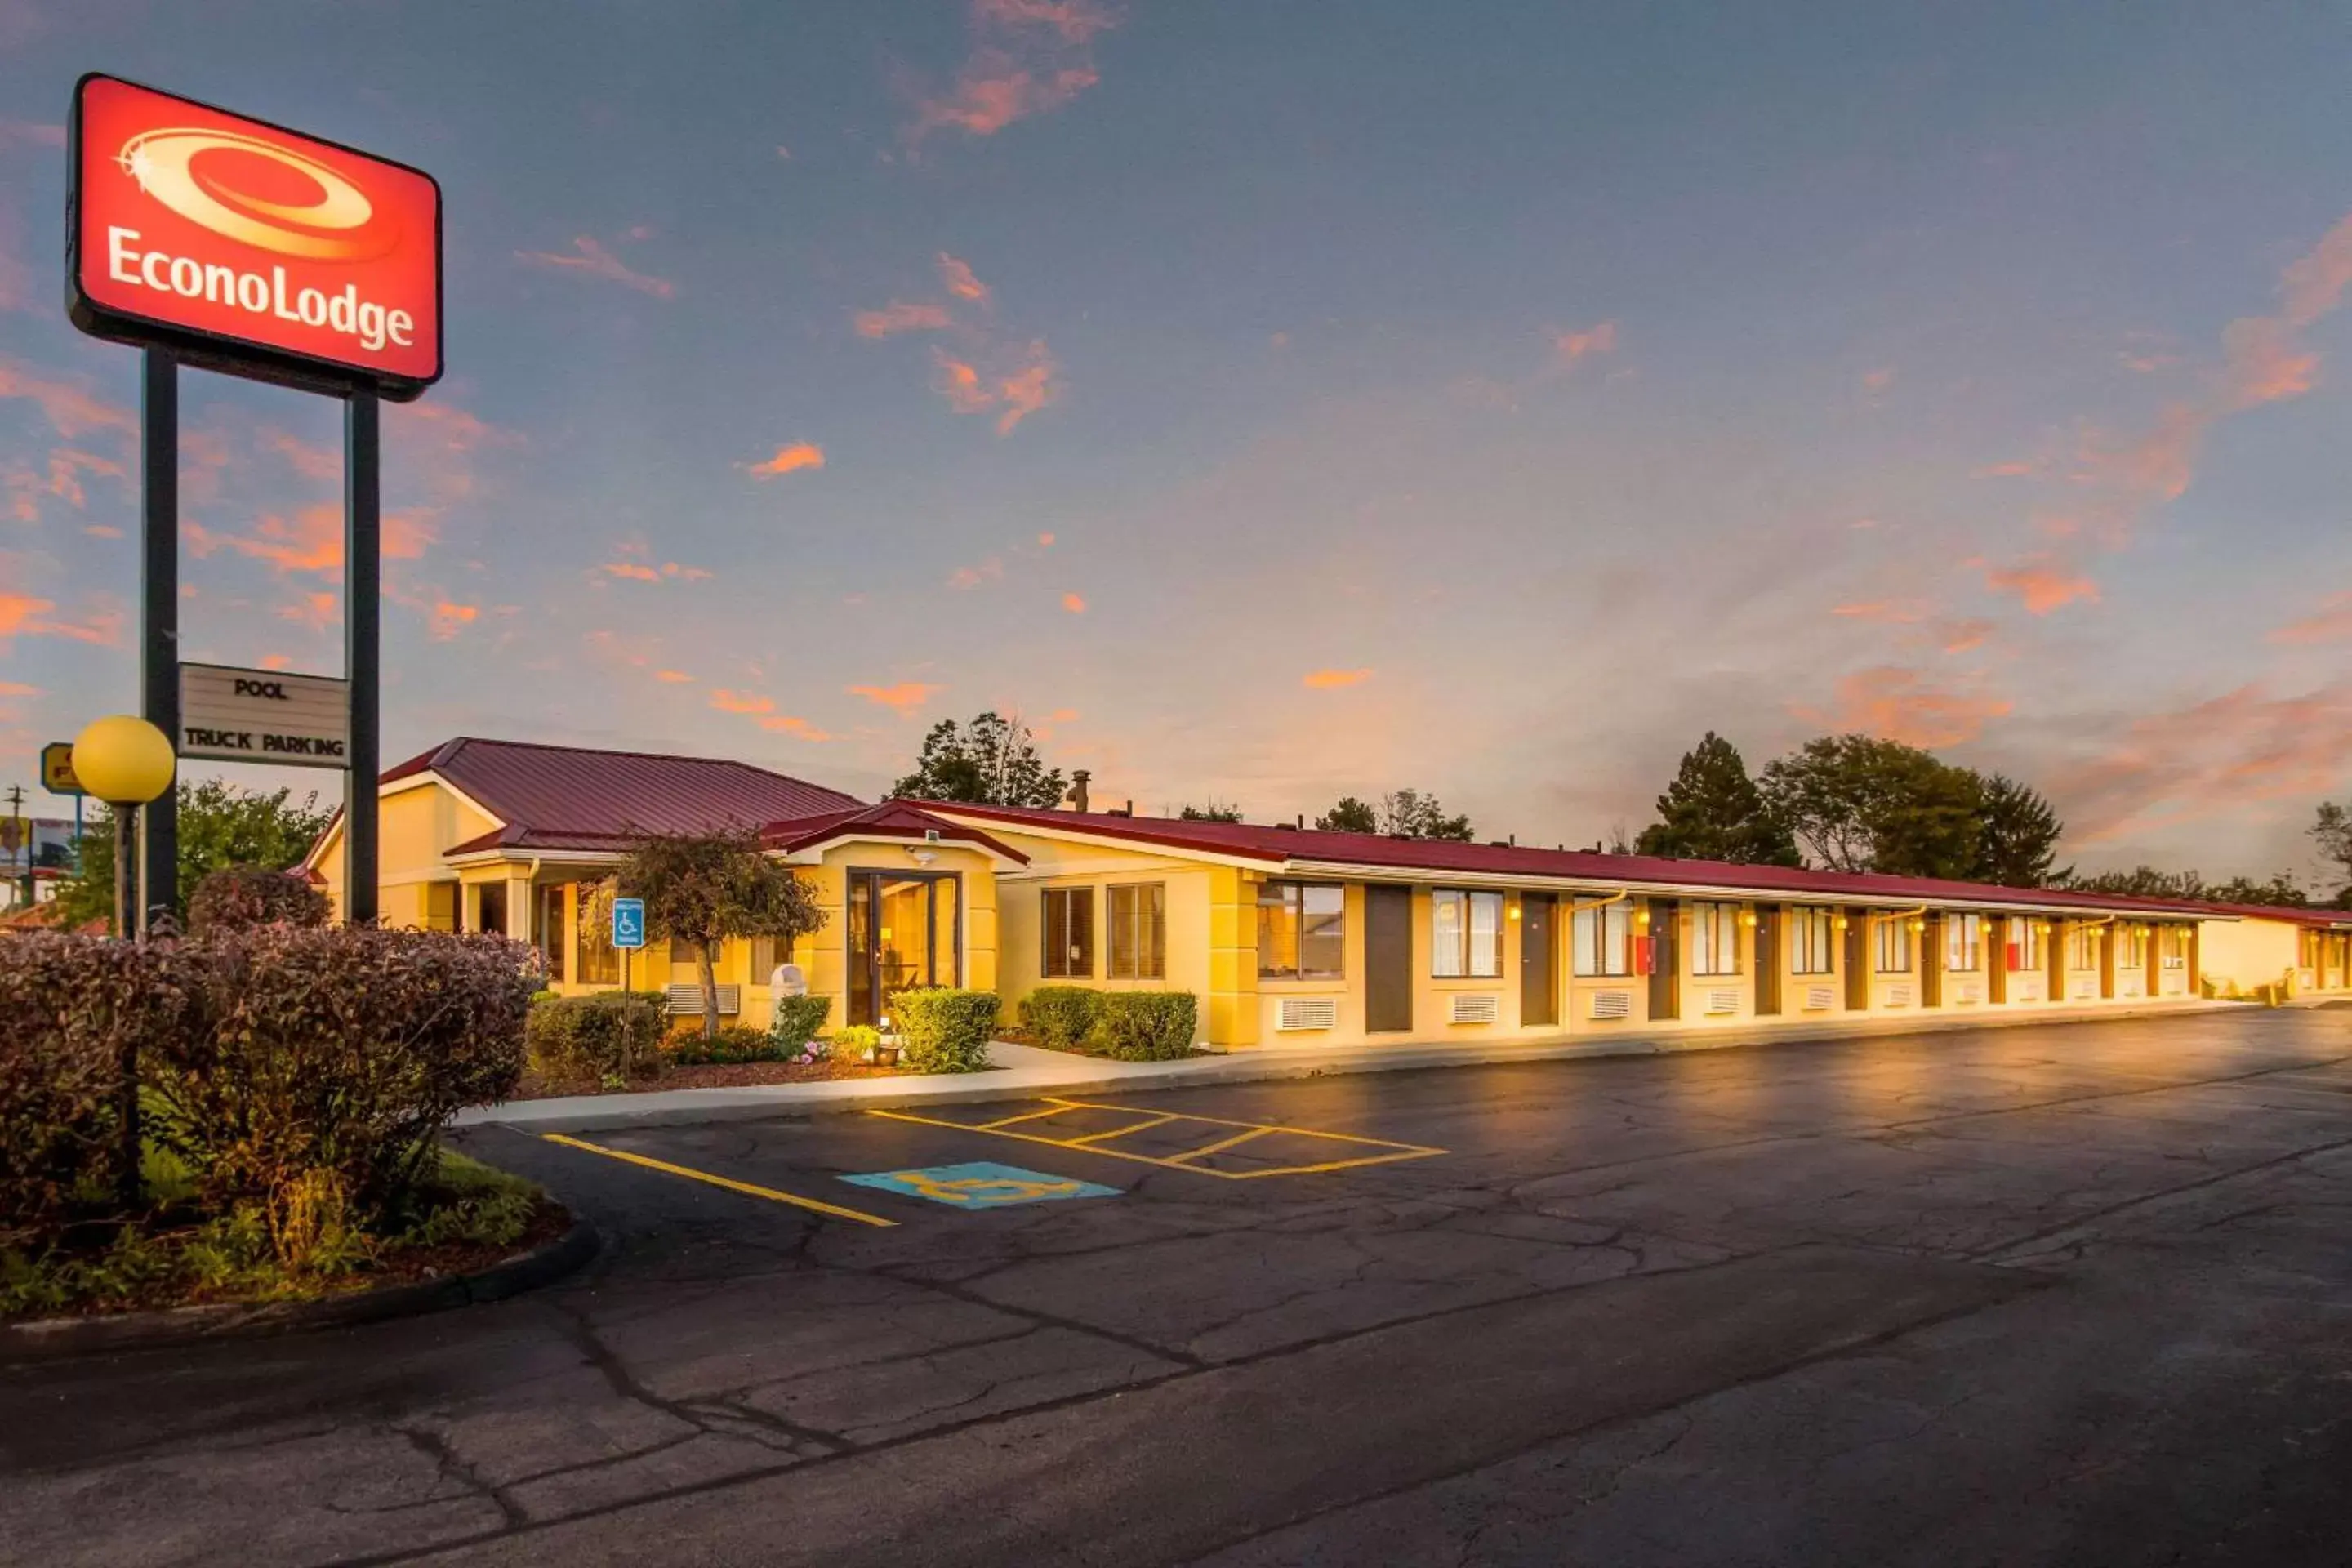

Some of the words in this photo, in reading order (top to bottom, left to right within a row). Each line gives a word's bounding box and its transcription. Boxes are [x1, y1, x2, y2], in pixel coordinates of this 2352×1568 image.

[108, 225, 413, 351] EconoLodge
[234, 679, 289, 700] POOL
[185, 728, 252, 750] TRUCK
[262, 733, 344, 755] PARKING
